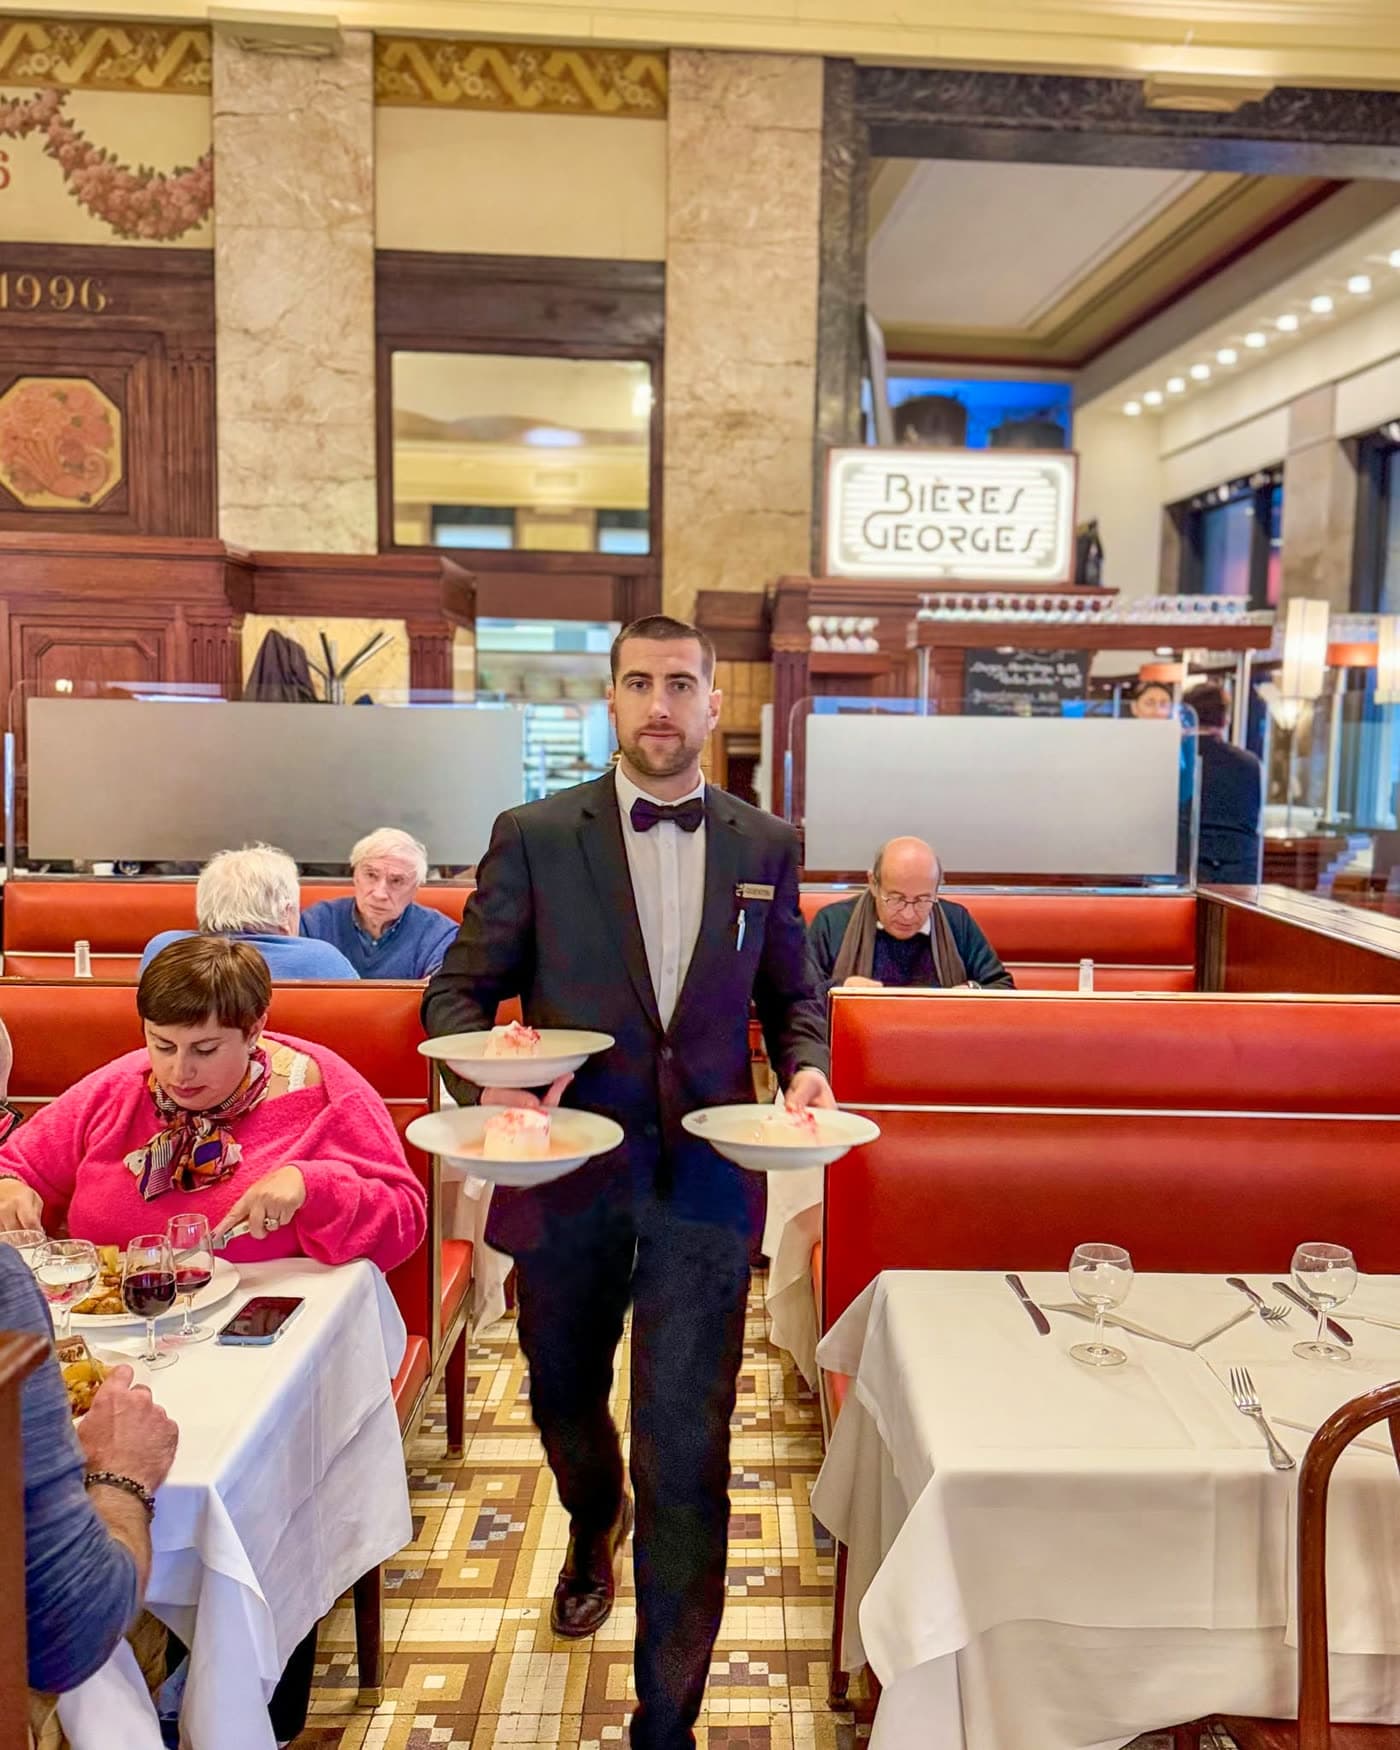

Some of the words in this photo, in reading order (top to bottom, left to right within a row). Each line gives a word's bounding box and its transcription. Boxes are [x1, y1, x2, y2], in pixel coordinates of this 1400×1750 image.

[0, 271, 106, 312] 1996
[884, 473, 1025, 515] BIÈRES
[863, 511, 1039, 553] GEORGES
